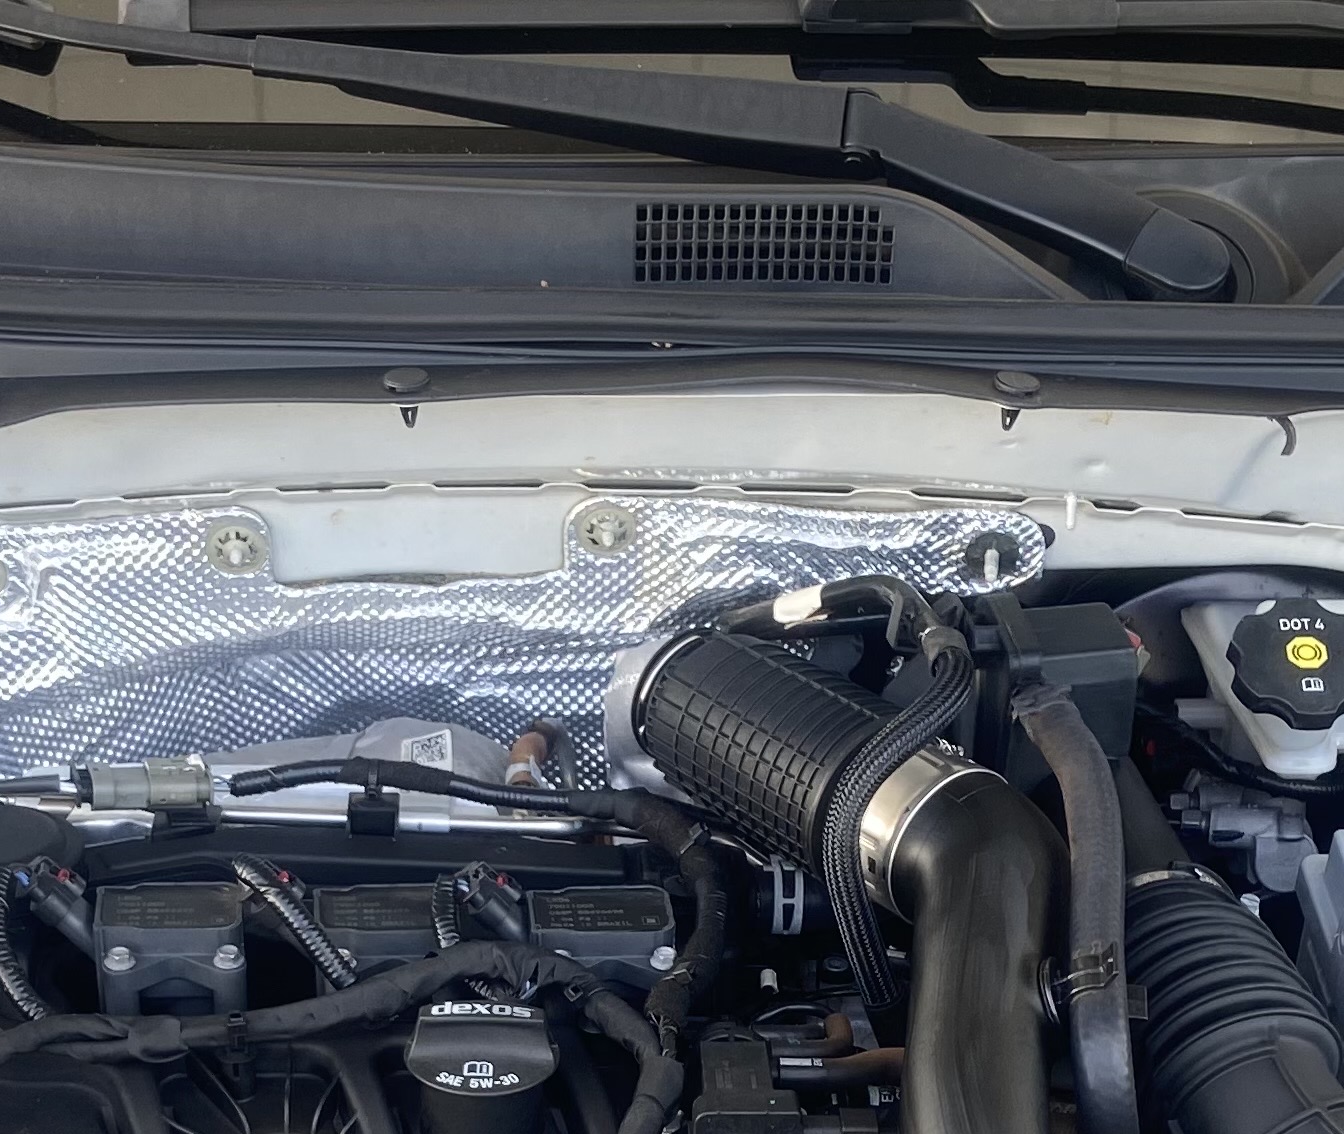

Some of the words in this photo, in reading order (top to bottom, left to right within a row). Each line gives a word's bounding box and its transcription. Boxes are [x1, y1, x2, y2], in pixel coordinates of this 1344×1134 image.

[1279, 618, 1310, 631] DOT
[1315, 618, 1325, 630] 4
[431, 1001, 533, 1018] dexos
[436, 1071, 465, 1088] SAE
[469, 1073, 520, 1089] 5W-30
